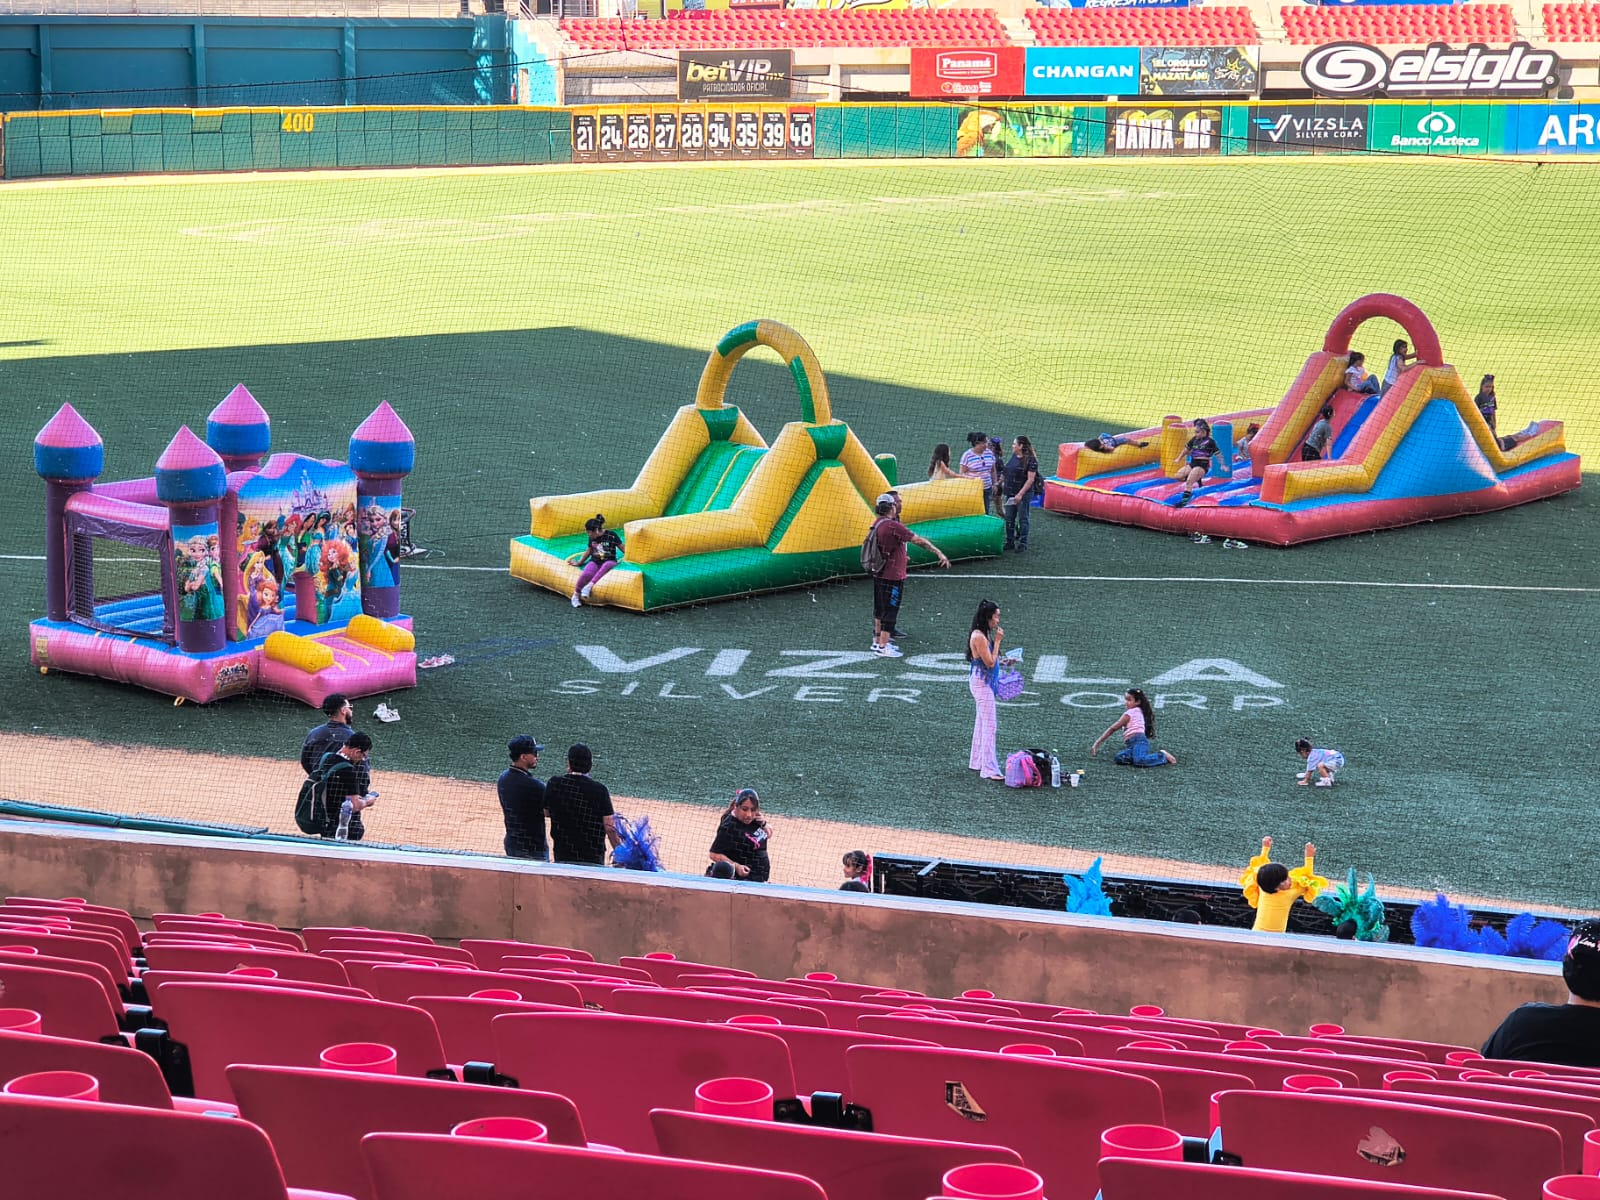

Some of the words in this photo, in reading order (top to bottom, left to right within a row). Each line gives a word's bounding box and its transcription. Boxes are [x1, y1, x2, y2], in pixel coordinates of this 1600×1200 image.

[942, 57, 991, 68] Panamá
[1032, 65, 1134, 78] CHANGAN
[746, 82, 768, 92] OFICIAL
[281, 113, 314, 133] 400
[708, 123, 730, 147] 34
[735, 123, 757, 147] 35
[763, 123, 784, 147] 39
[790, 122, 812, 147] 48
[1115, 118, 1175, 149] BANDA
[1293, 117, 1364, 130] VIZSLA
[1295, 130, 1329, 139] SILVER
[1333, 130, 1362, 138] CORP.
[1537, 113, 1600, 146] AR
[577, 126, 593, 151] 21
[600, 125, 623, 150] 24
[628, 124, 649, 149] 26
[655, 124, 676, 148] 27
[682, 123, 703, 148] 28
[1391, 135, 1431, 146] Banco
[1433, 135, 1480, 146] Azteca
[574, 645, 1286, 689] VIZSLA
[551, 679, 923, 704] SILVER
